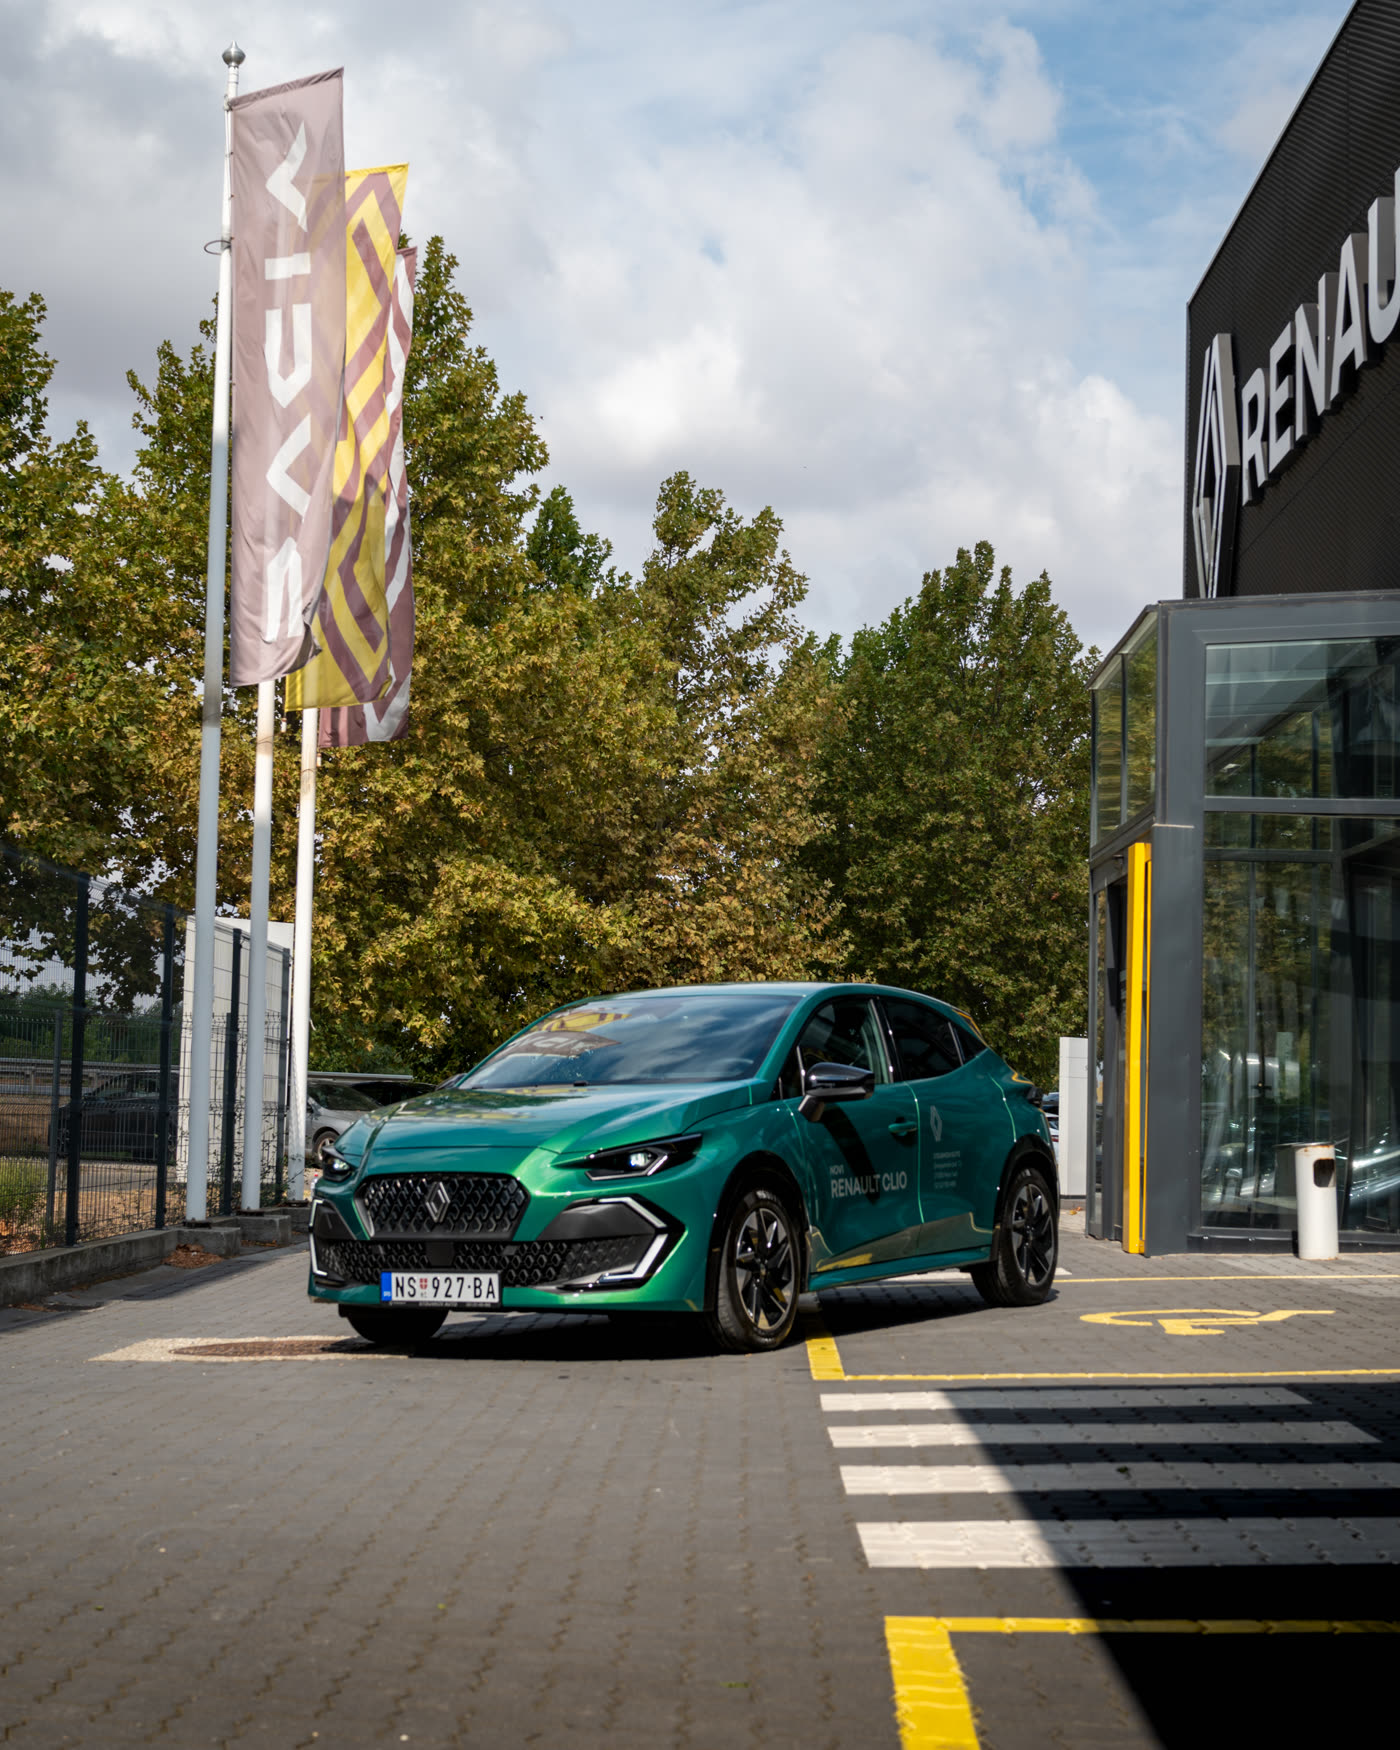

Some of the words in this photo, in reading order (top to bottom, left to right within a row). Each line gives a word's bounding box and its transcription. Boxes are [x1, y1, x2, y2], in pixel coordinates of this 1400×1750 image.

[264, 121, 312, 643] DACIA
[829, 1164, 845, 1176] NOVI
[831, 1174, 881, 1199] RENAULT
[882, 1171, 908, 1192] CLIO
[395, 1276, 417, 1298] NS
